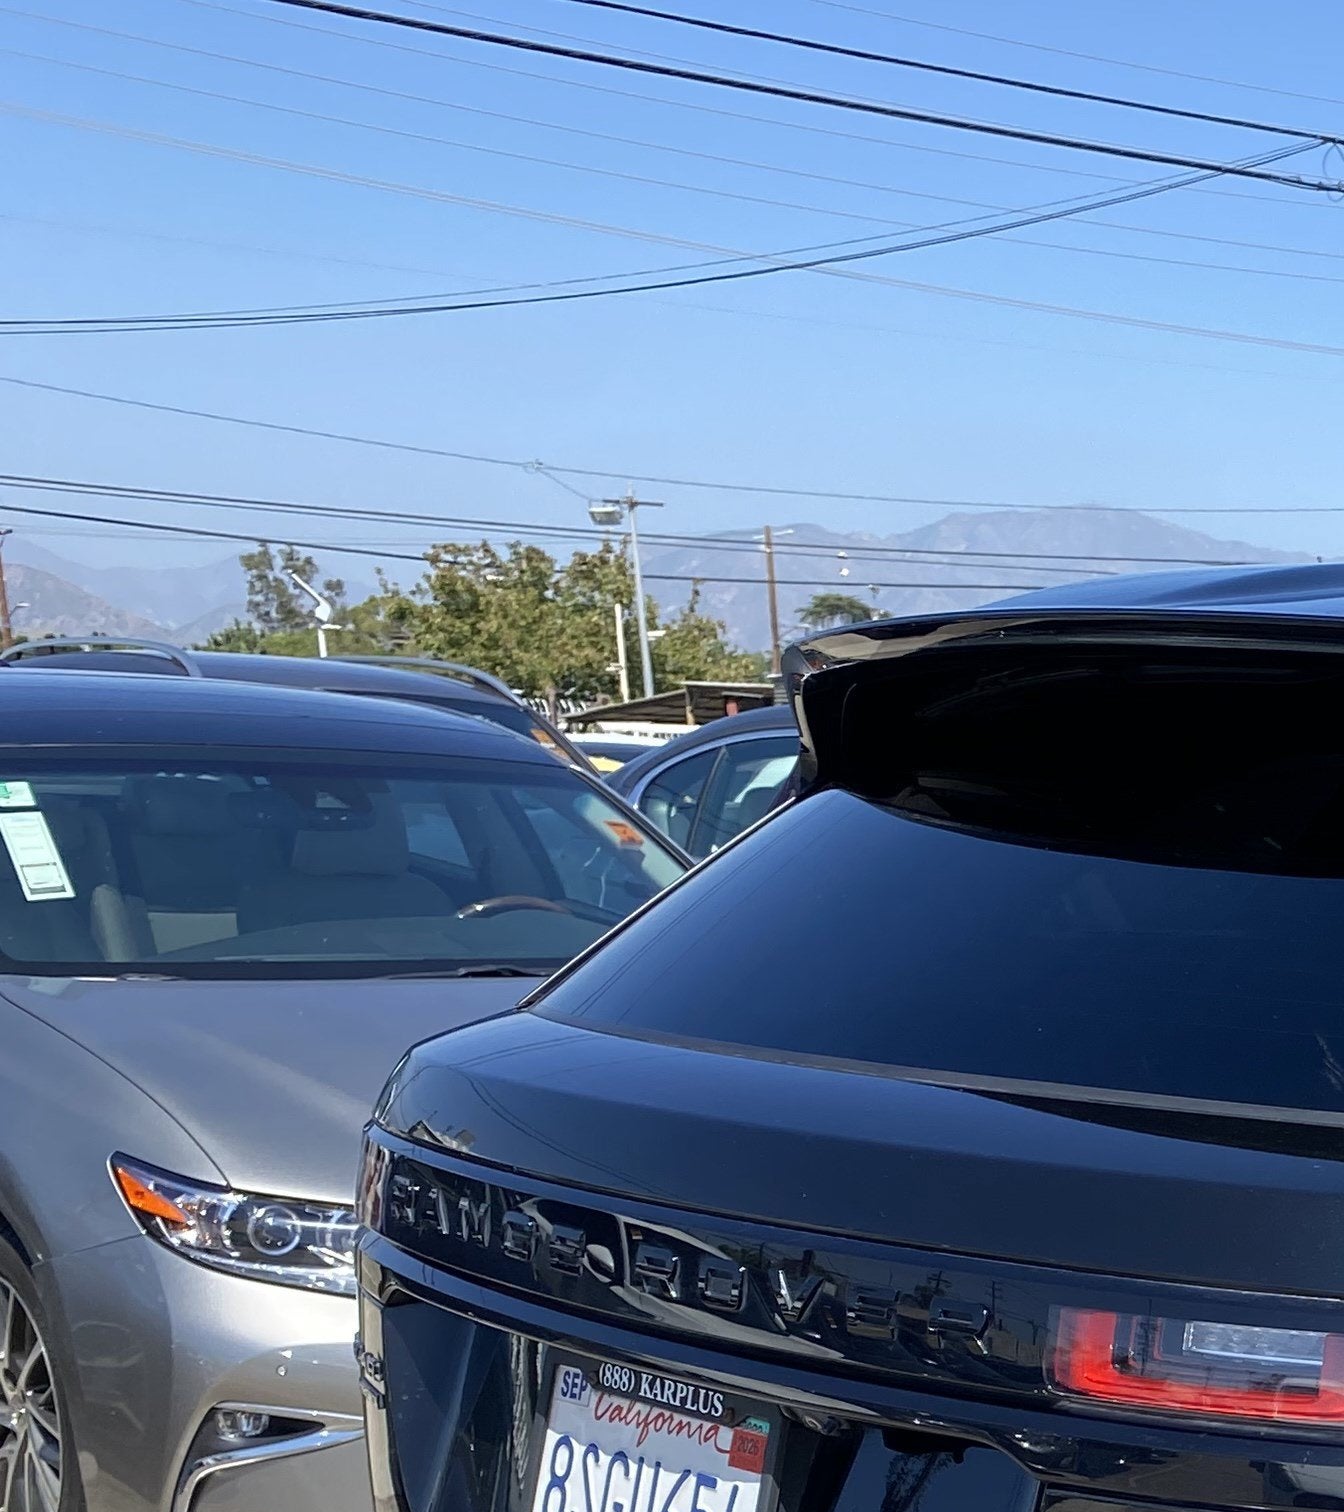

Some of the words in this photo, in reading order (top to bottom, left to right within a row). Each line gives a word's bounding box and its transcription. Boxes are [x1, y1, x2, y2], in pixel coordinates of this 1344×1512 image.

[560, 1368, 587, 1401] SEP
[598, 1361, 635, 1393] (888)
[638, 1371, 724, 1417] KARPLUS
[593, 1392, 731, 1453] California
